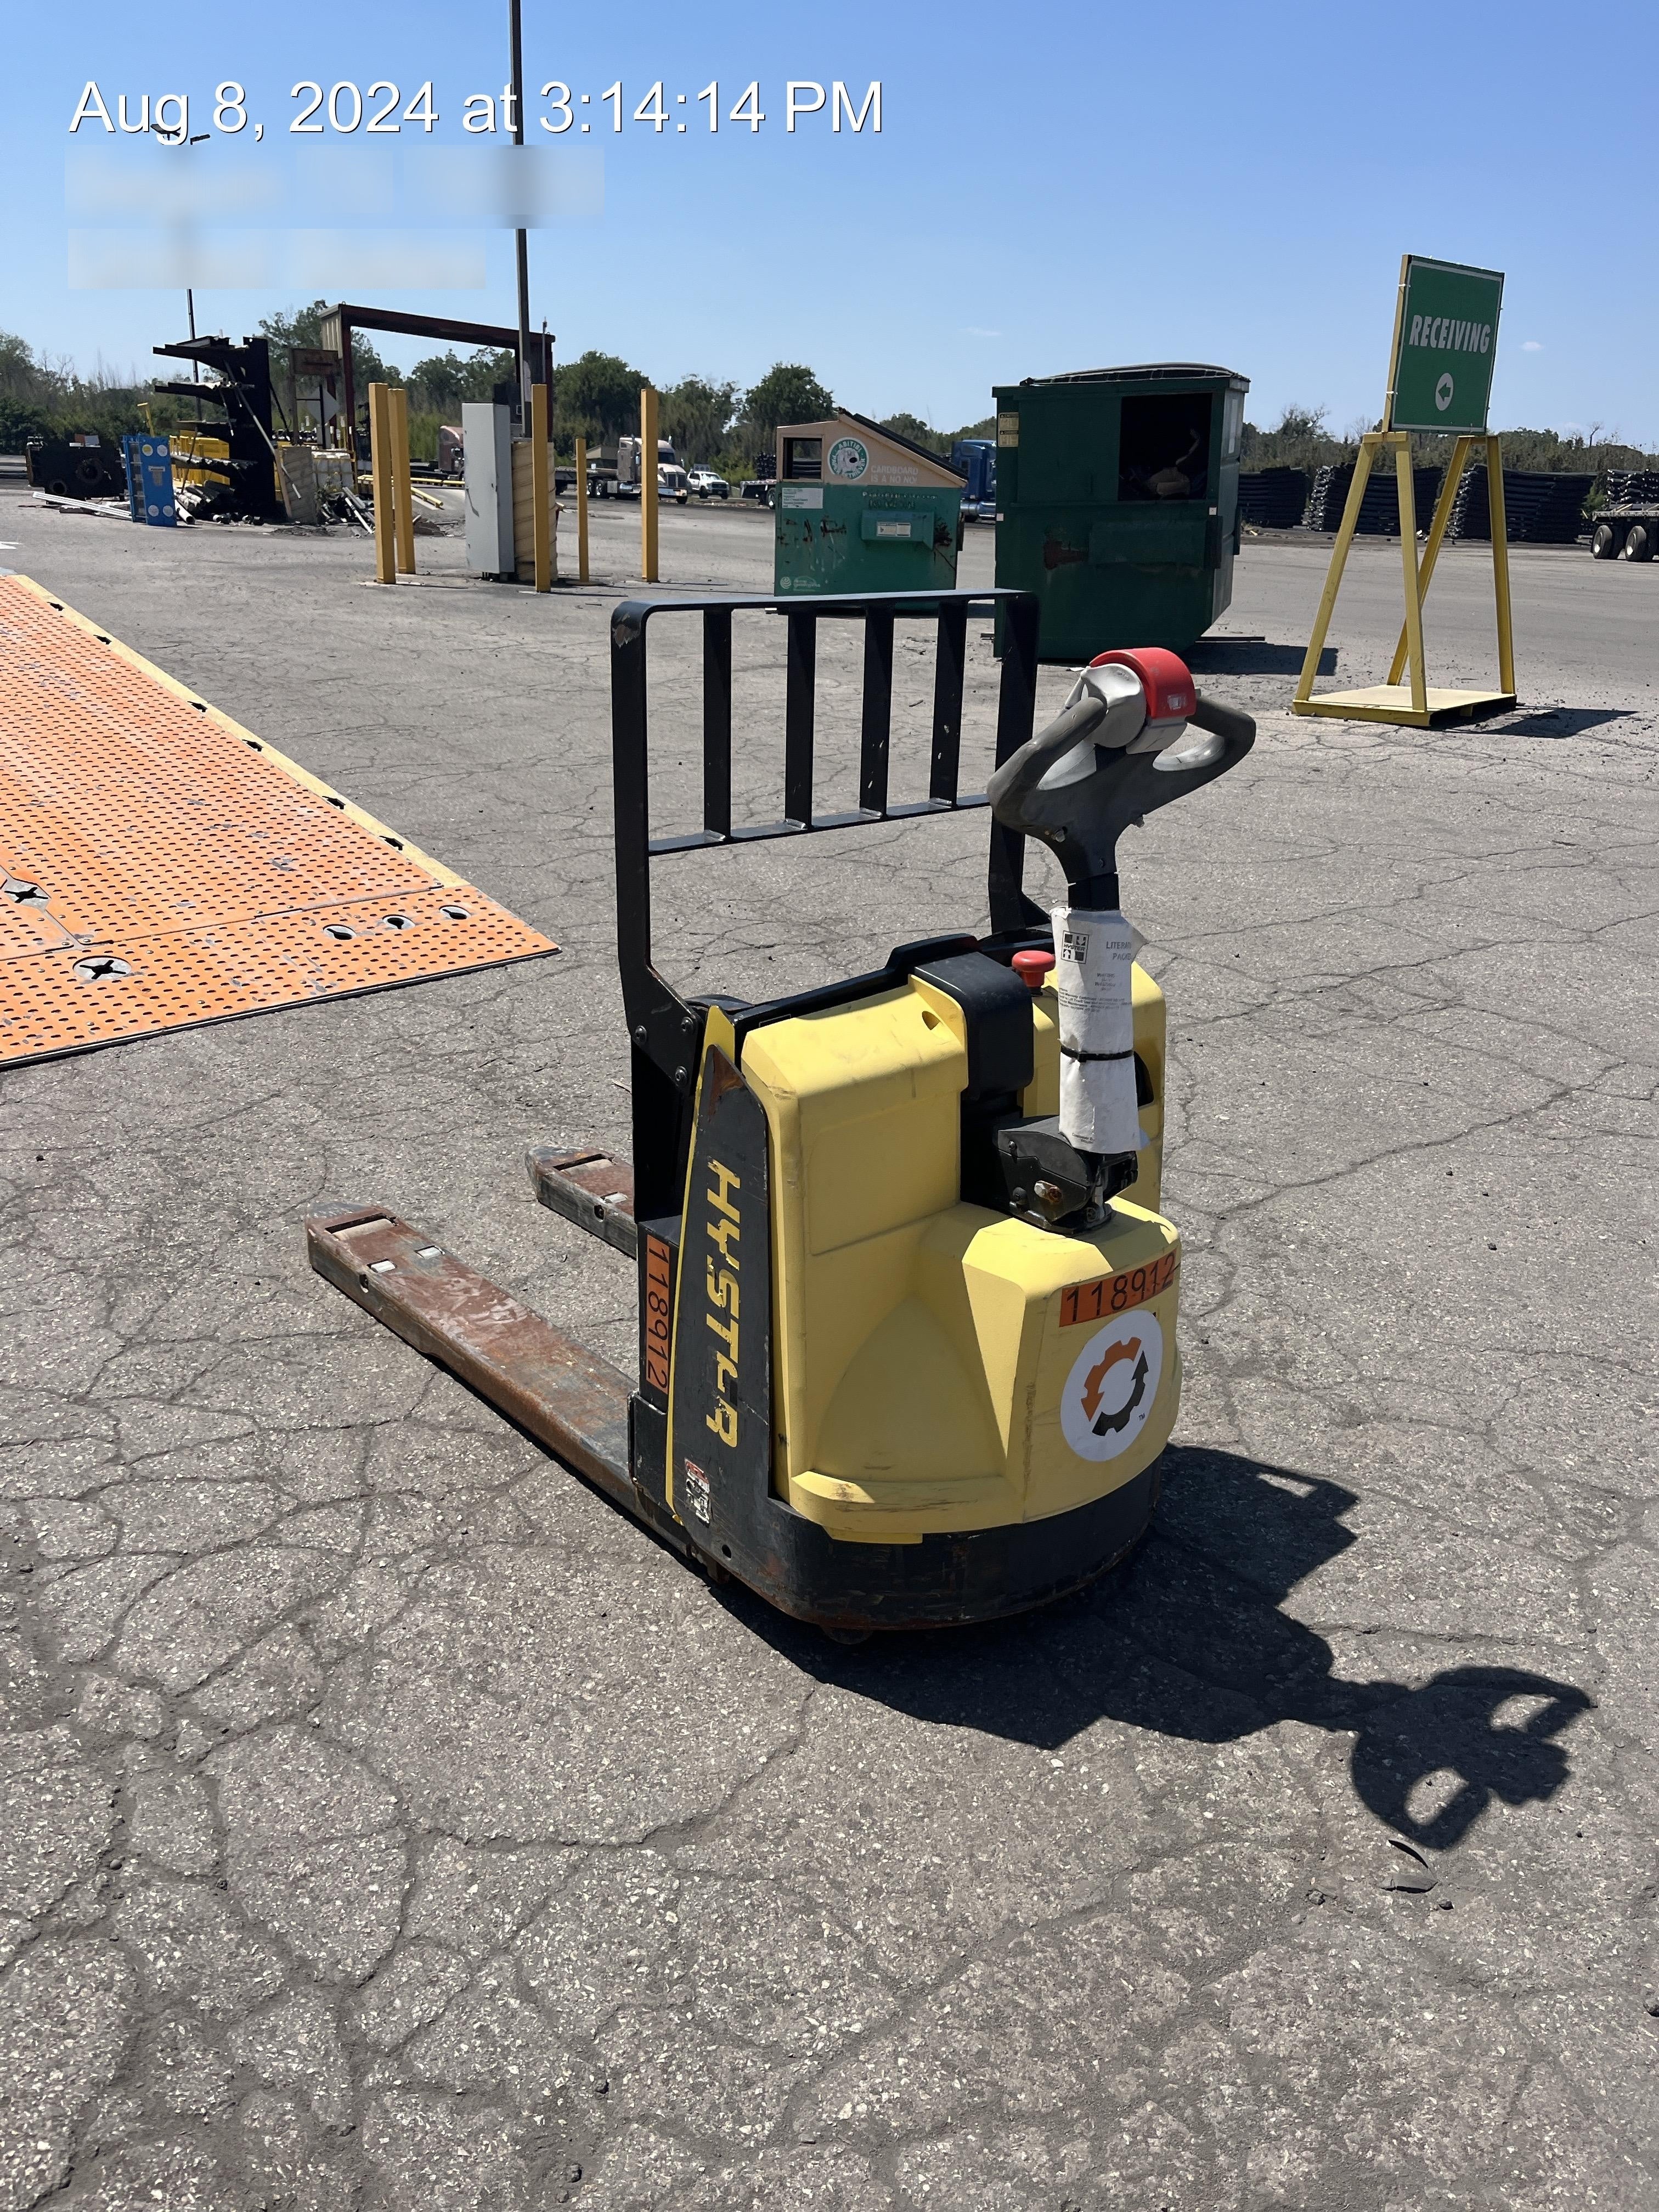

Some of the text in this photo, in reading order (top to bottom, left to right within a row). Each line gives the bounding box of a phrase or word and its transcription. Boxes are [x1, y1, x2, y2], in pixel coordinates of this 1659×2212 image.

[1409, 314, 1491, 354] RECEIVING
[871, 465, 919, 476] CARDBOARD
[1063, 944, 1085, 952] HYSTER
[1066, 1252, 1176, 1322] 118912
[648, 1243, 669, 1389] 118912
